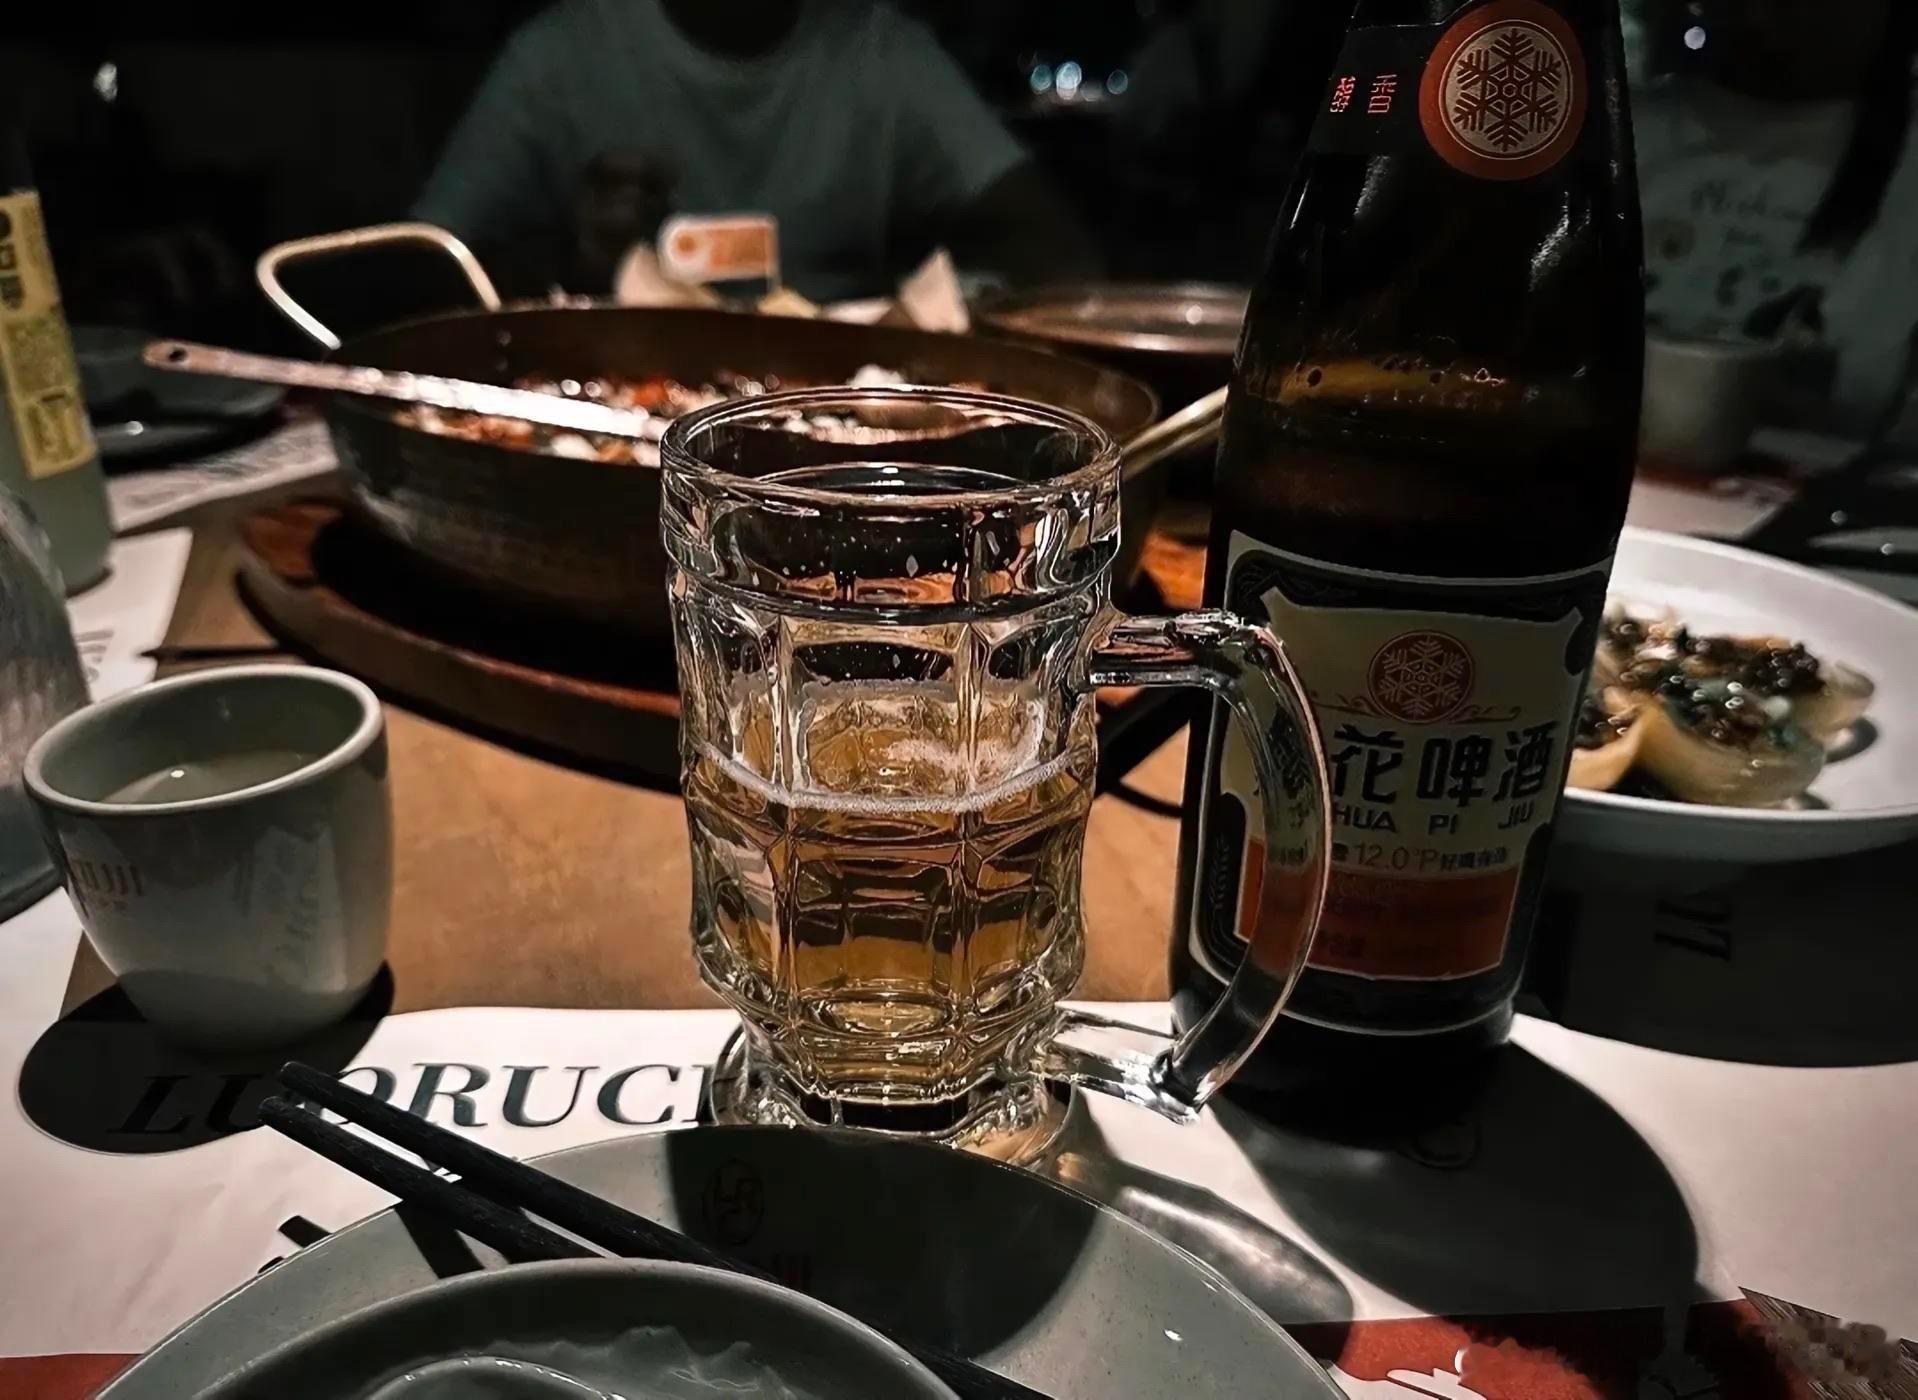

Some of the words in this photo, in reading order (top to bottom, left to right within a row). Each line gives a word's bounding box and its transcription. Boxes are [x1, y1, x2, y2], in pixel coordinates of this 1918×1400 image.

[1334, 803, 1397, 833] HUA
[1428, 814, 1459, 834] PI
[1499, 801, 1535, 829] JIU
